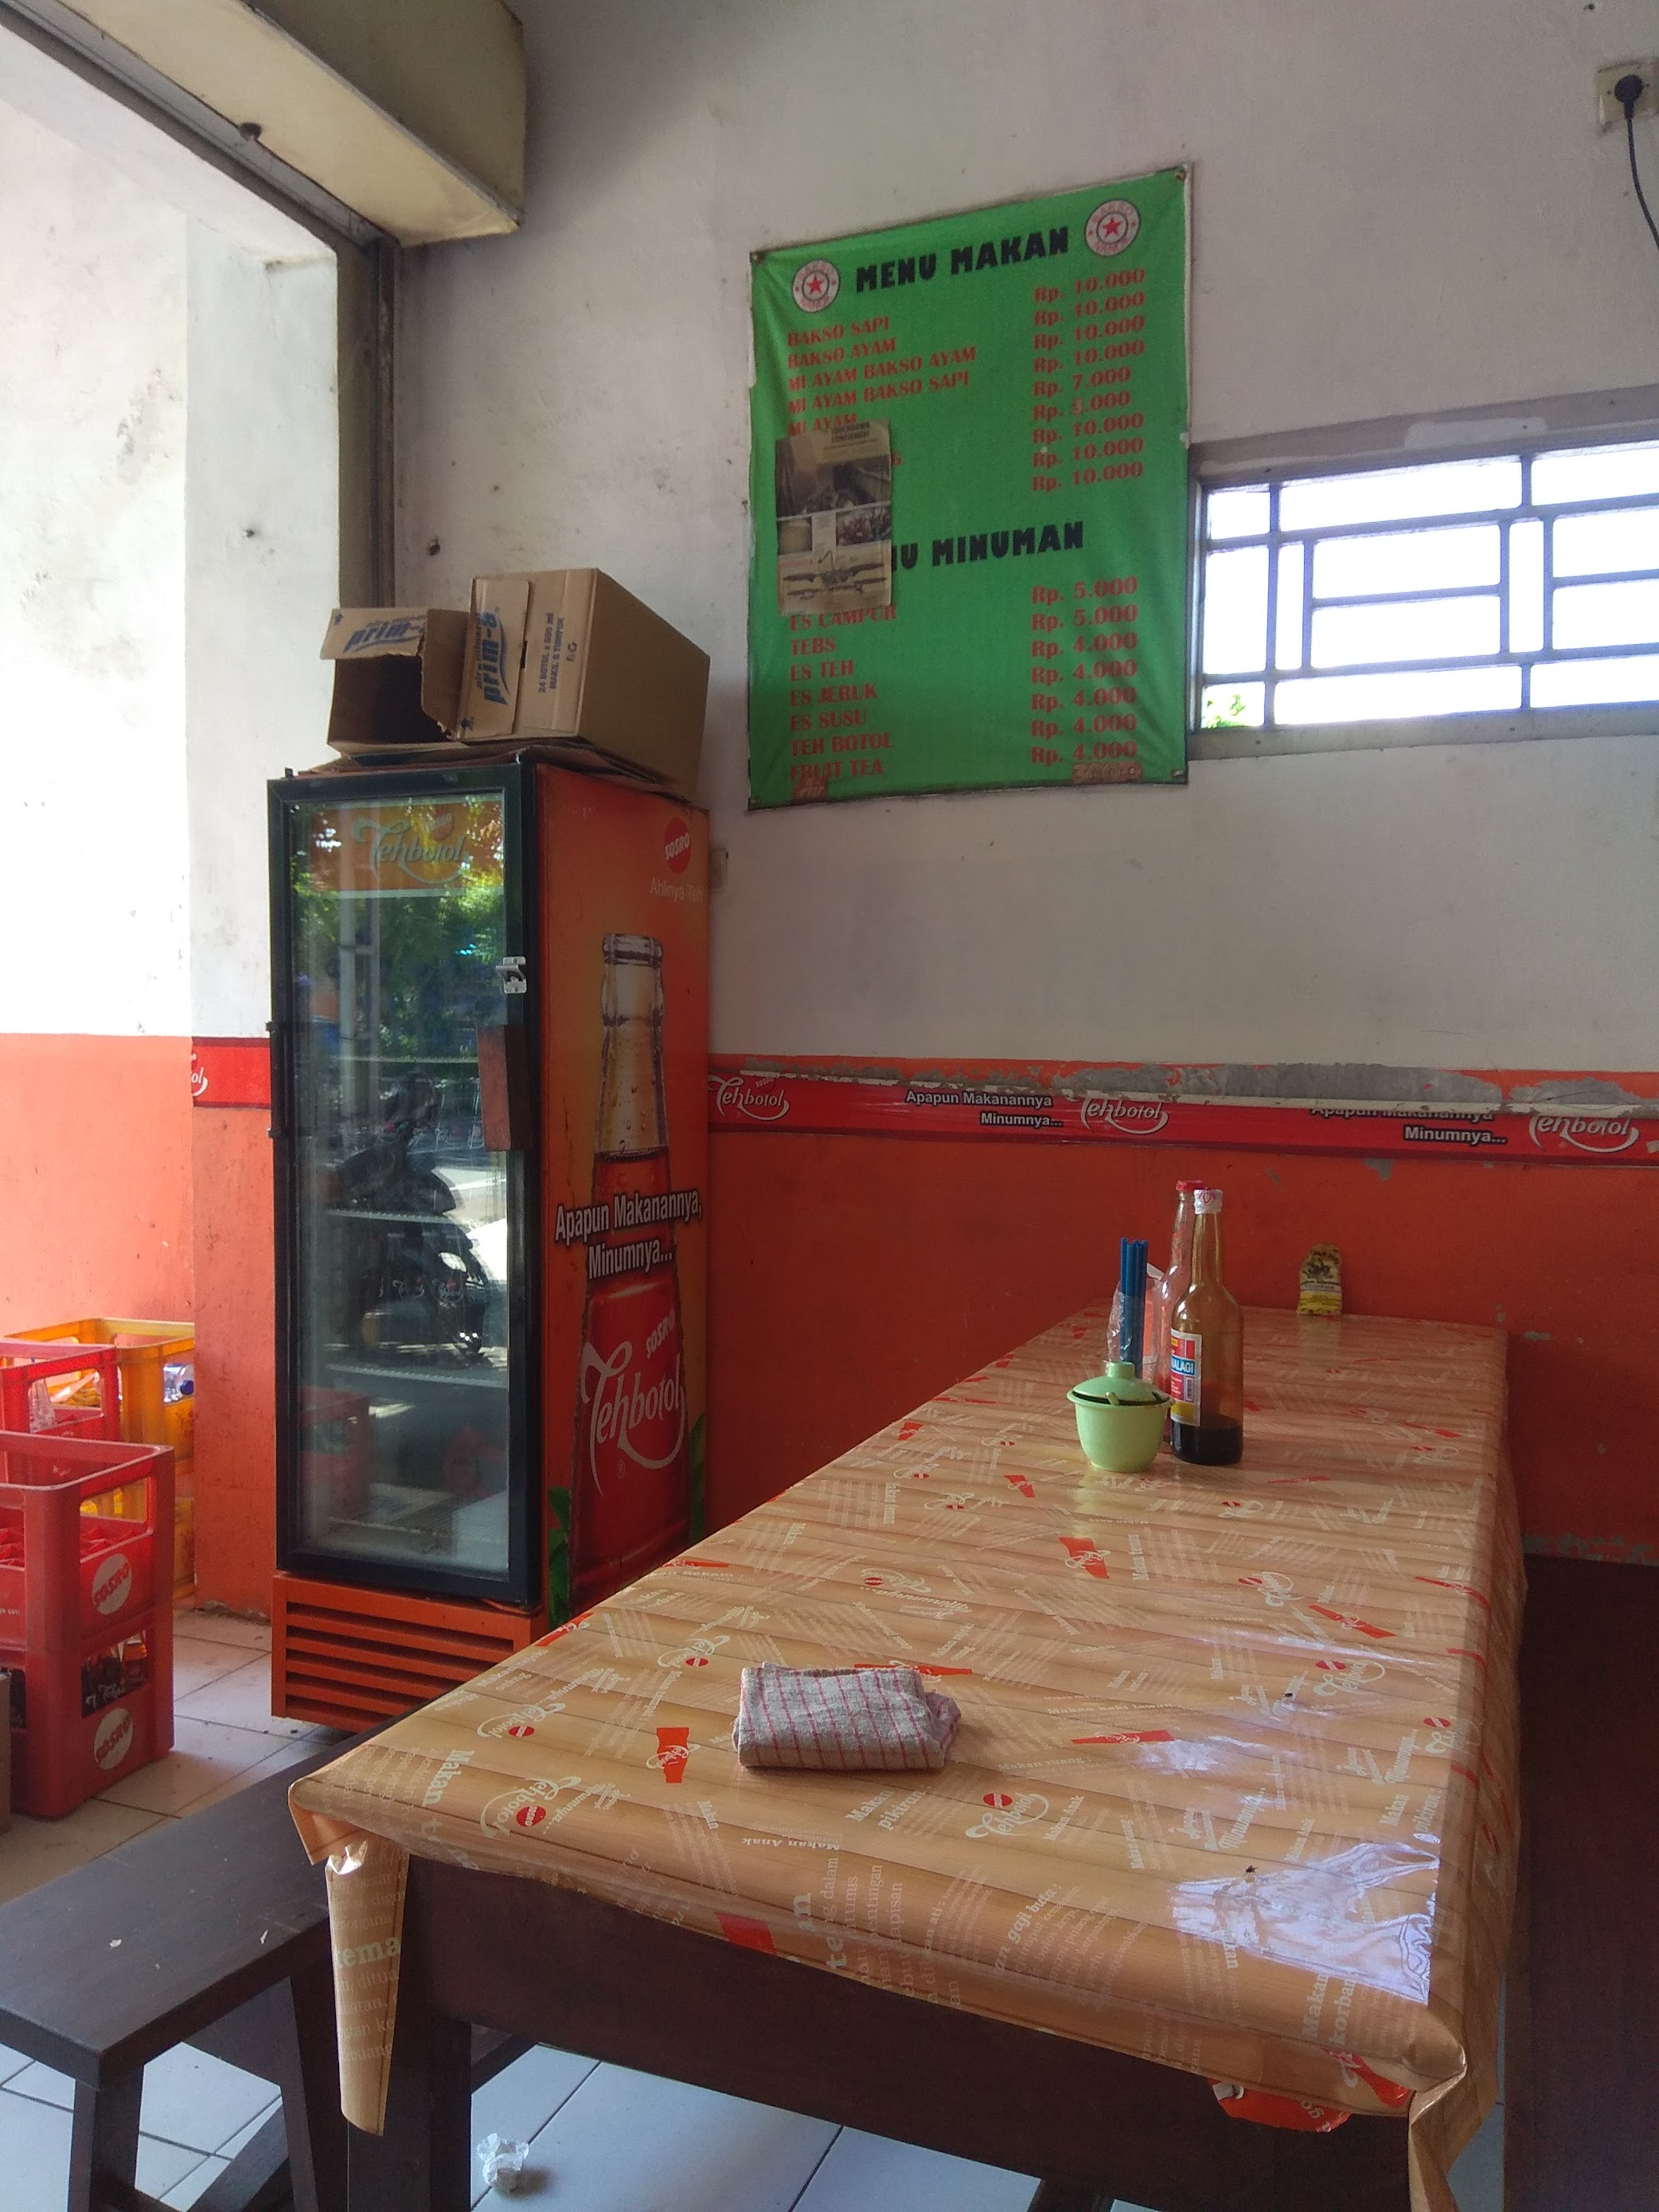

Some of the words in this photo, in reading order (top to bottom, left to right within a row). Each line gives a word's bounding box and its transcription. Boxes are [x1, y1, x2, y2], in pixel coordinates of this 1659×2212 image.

[856, 253, 936, 293] MENU
[951, 226, 1068, 275] MAKAN
[1034, 287, 1064, 302] Rp.
[1075, 267, 1146, 295] 10.000
[1034, 310, 1064, 326] Rp.
[1075, 291, 1145, 319] 10.000
[787, 324, 845, 347] BAKSO
[851, 316, 889, 335] SAPI
[1033, 333, 1063, 350] Rp.
[1075, 314, 1146, 343] 10.000
[787, 347, 845, 369] BAKSO
[851, 337, 896, 357] AYAM
[788, 375, 806, 391] MI
[813, 367, 857, 387] AYAM
[863, 356, 923, 380] BAKSO
[930, 345, 976, 367] AYAM
[1033, 357, 1063, 374] Rp.
[1074, 340, 1146, 366] 10.000
[787, 397, 806, 415] MI
[813, 390, 857, 408] AYAM
[863, 379, 923, 403] BAKSO
[929, 370, 969, 390] SAPI
[1033, 380, 1063, 399] Rp.
[1072, 365, 1131, 390] 7.000
[1032, 428, 1063, 445] Rp.
[1073, 412, 1144, 439] 10.000
[1033, 404, 1063, 421] Rp.
[1032, 451, 1063, 469] Rp.
[1073, 437, 1144, 461] 10.000
[1032, 475, 1063, 493] Rp.
[1073, 462, 1143, 485] 10.000
[932, 521, 1083, 566] MINUMAN
[1032, 587, 1064, 606] Rp.
[1075, 576, 1138, 599] 5.000
[1032, 614, 1063, 633] Rp.
[1075, 604, 1138, 626] 5.000
[792, 637, 836, 656] TEBS
[1032, 640, 1064, 659] Rp.
[1073, 632, 1137, 652] 4.000
[790, 665, 812, 681] ES
[821, 659, 853, 678] TEH
[1032, 667, 1063, 687] Rp.
[1074, 659, 1137, 680] 4.000
[790, 690, 812, 707] ES
[1032, 693, 1063, 713] Rp.
[1073, 687, 1137, 706] 4.000
[790, 714, 813, 732] ES
[818, 708, 866, 729] SUSU
[1031, 720, 1063, 739] Rp.
[1073, 713, 1137, 733] 4.000
[790, 738, 825, 758] TEH
[830, 732, 893, 754] BOTOL
[1031, 746, 1063, 767] Rp.
[1072, 740, 1138, 761] 4.000
[790, 760, 842, 782] FRUIT
[849, 758, 884, 777] TEA
[353, 817, 473, 884] Tehbotol
[708, 1075, 790, 1122] Tehbotol
[905, 1090, 959, 1107] Apapun
[962, 1091, 1052, 1110] Makanannya
[980, 1112, 1063, 1129] Minumnya...
[1403, 1125, 1509, 1145] Minumnya...
[555, 1203, 610, 1246] Apapun
[613, 1188, 702, 1229] Makanannya,
[588, 1238, 673, 1280] Minumnya...
[580, 1340, 685, 1496] Tehbotol
[423, 1750, 474, 1806] Makan
[481, 1777, 582, 1839] Tehbotol
[845, 1790, 892, 1822] Makan
[742, 1837, 784, 1847] Anak
[788, 1839, 841, 1851] Makan
[820, 1857, 839, 1899] dalam
[1008, 1910, 1032, 1945] gaji
[1302, 1974, 1329, 2042] Makan
[1329, 1978, 1357, 2046] korban
